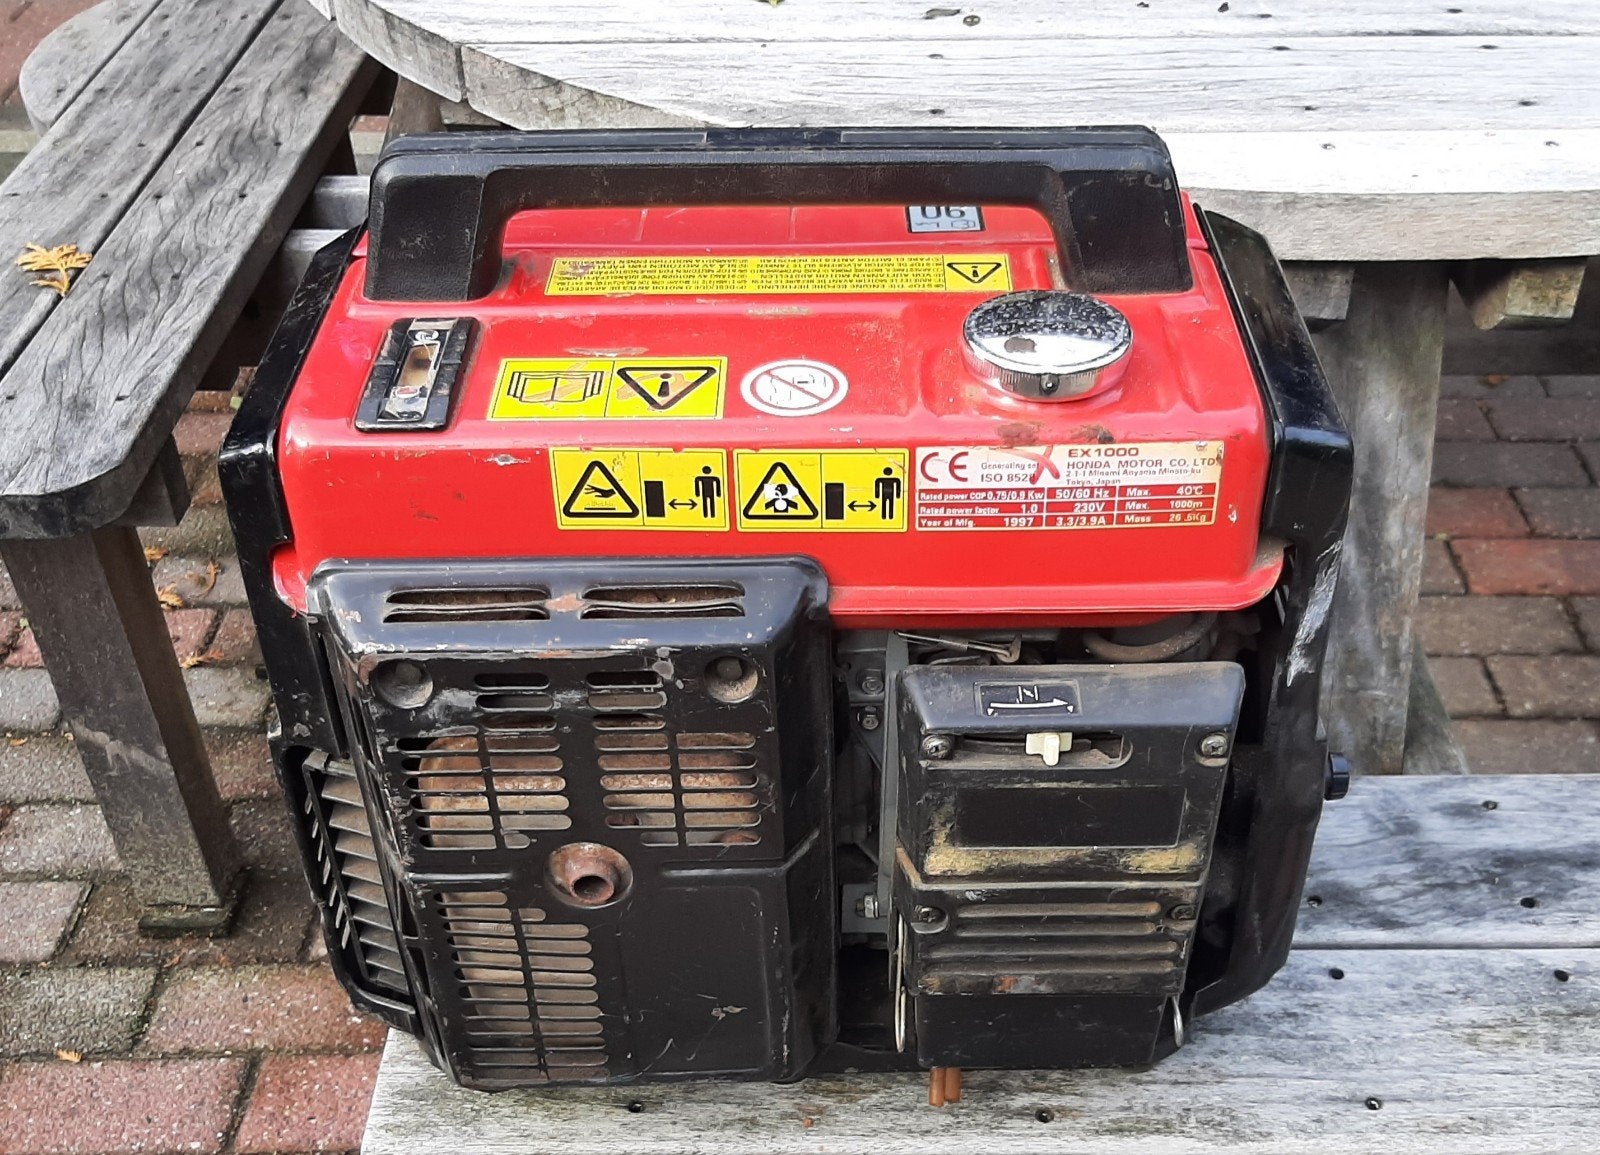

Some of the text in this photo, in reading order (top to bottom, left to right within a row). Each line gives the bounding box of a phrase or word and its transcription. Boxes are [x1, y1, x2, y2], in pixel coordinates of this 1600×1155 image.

[1068, 448, 1139, 458] EX1000
[921, 452, 968, 482] CE
[981, 462, 1026, 470] Generating
[1067, 460, 1110, 469] HONDA
[1118, 459, 1163, 469] MOTOR
[980, 474, 1002, 482] ISO
[1096, 478, 1120, 486] Japan
[970, 491, 986, 499] COP
[1028, 490, 1043, 499] Kw
[1055, 488, 1110, 499] 50/60 Hz
[1126, 488, 1151, 496] Max.
[1021, 504, 1038, 513] 1.0
[1074, 503, 1105, 512] 230V
[1125, 500, 1203, 510] Max. 1000m
[955, 518, 976, 527] Mfg.
[1003, 517, 1034, 527] 1997
[1056, 516, 1106, 526] 3.3/3.9A
[1124, 515, 1151, 523] Mass
